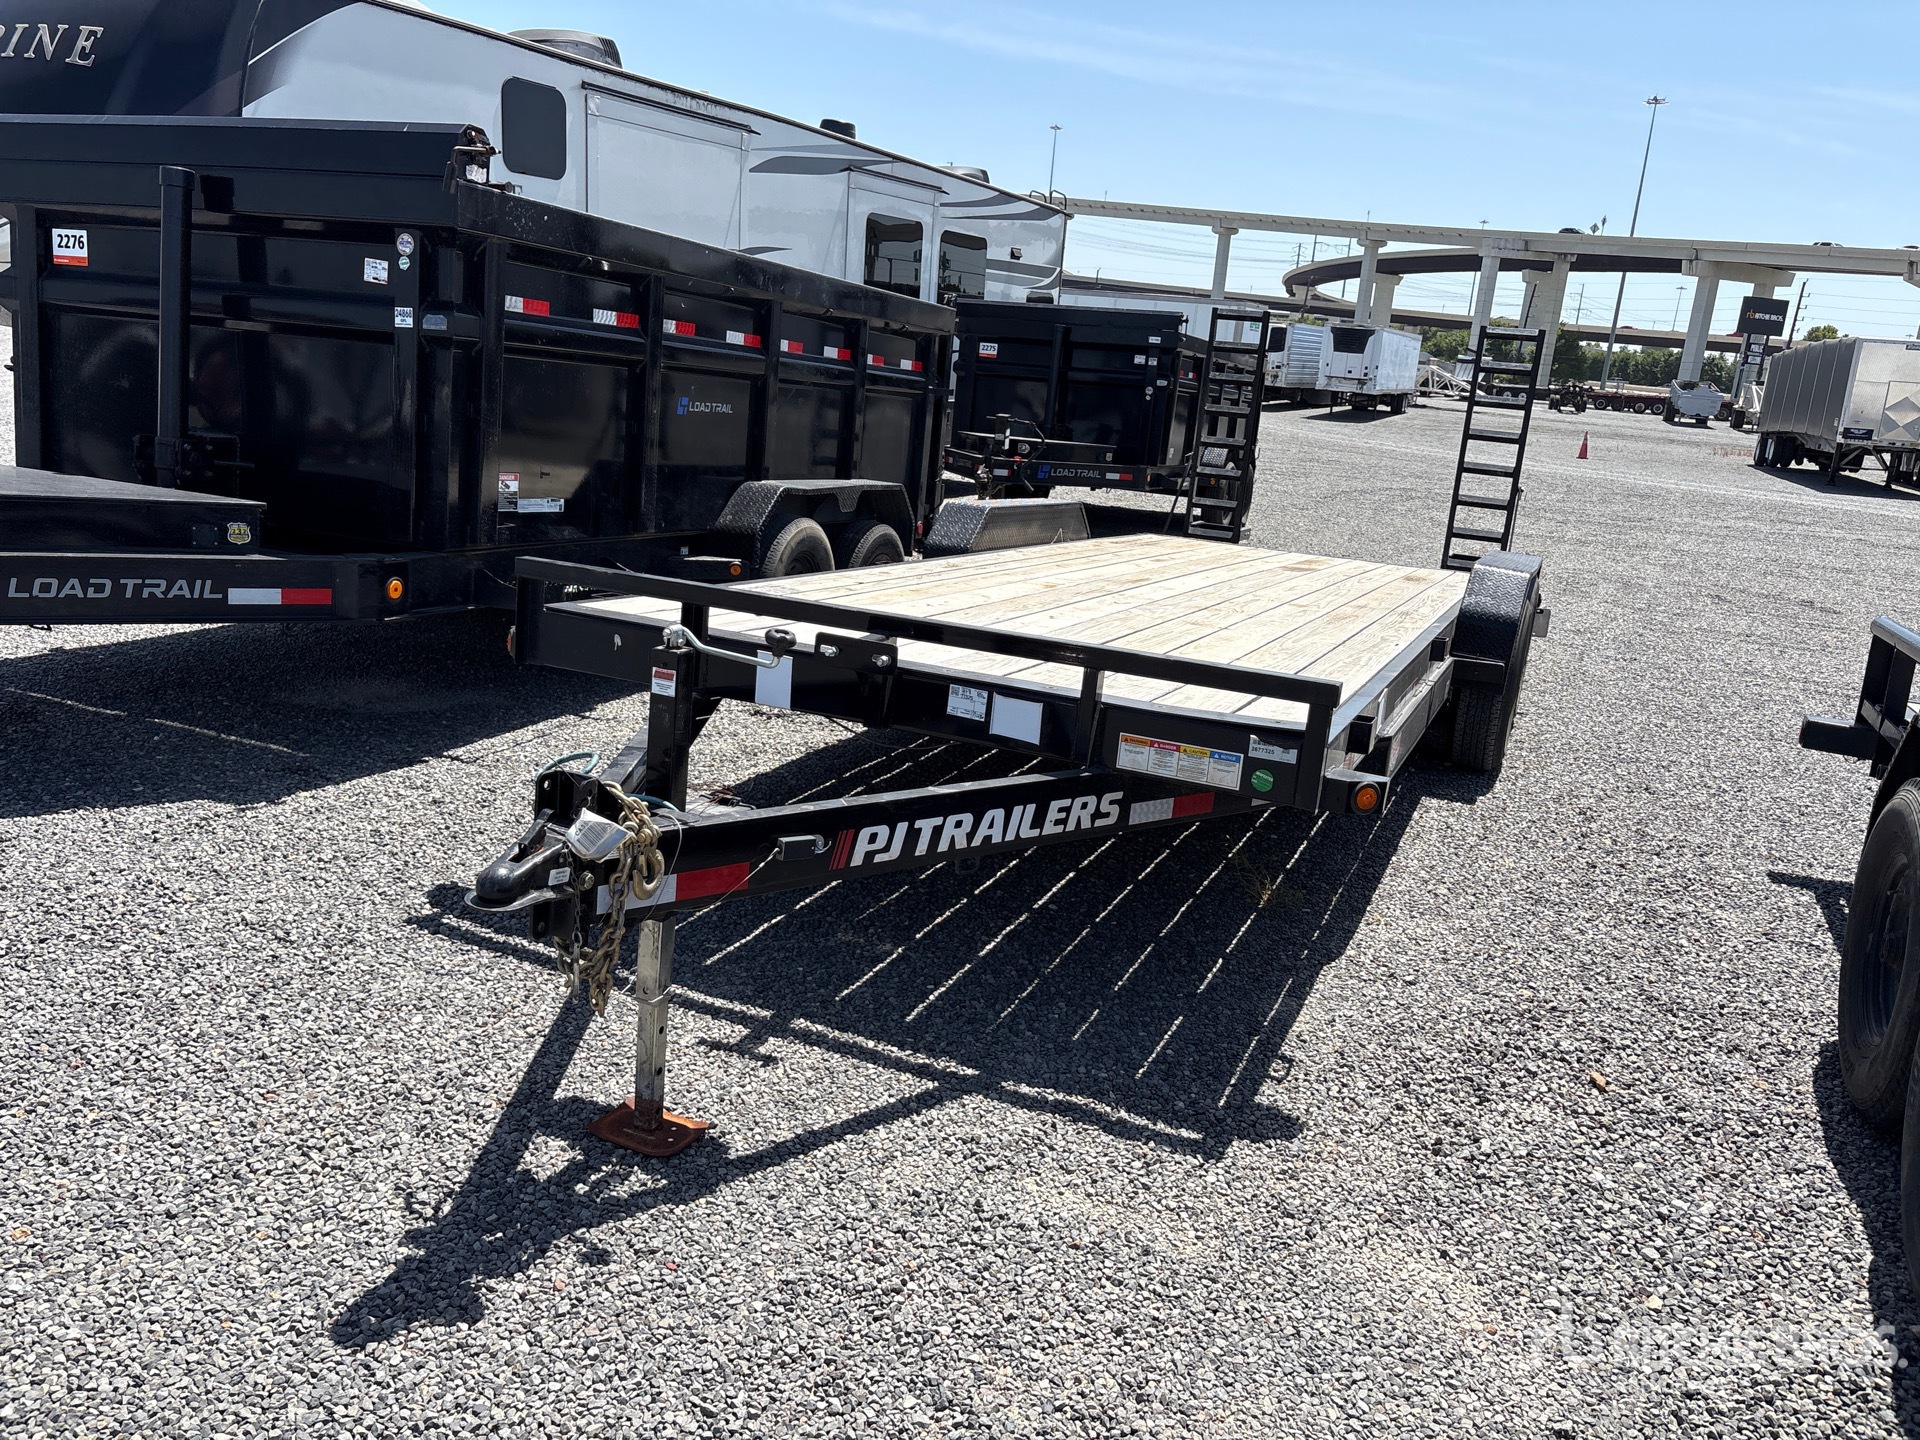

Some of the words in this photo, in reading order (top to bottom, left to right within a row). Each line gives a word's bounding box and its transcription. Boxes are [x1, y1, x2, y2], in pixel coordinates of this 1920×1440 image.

[57, 234, 85, 250] 2276
[981, 344, 997, 352] 2275
[689, 401, 711, 412] LOAD
[711, 403, 733, 414] TRAIL
[1050, 468, 1076, 477] LOAD
[1076, 469, 1101, 478] TRAIL
[7, 577, 113, 598] LOAD
[119, 578, 223, 599] TRAIL
[1129, 737, 1149, 745] WARNING
[1188, 748, 1208, 756] CAUTION
[1251, 746, 1275, 755] 2677325
[850, 822, 909, 867] PJ
[913, 791, 1124, 857] TRAILERS
